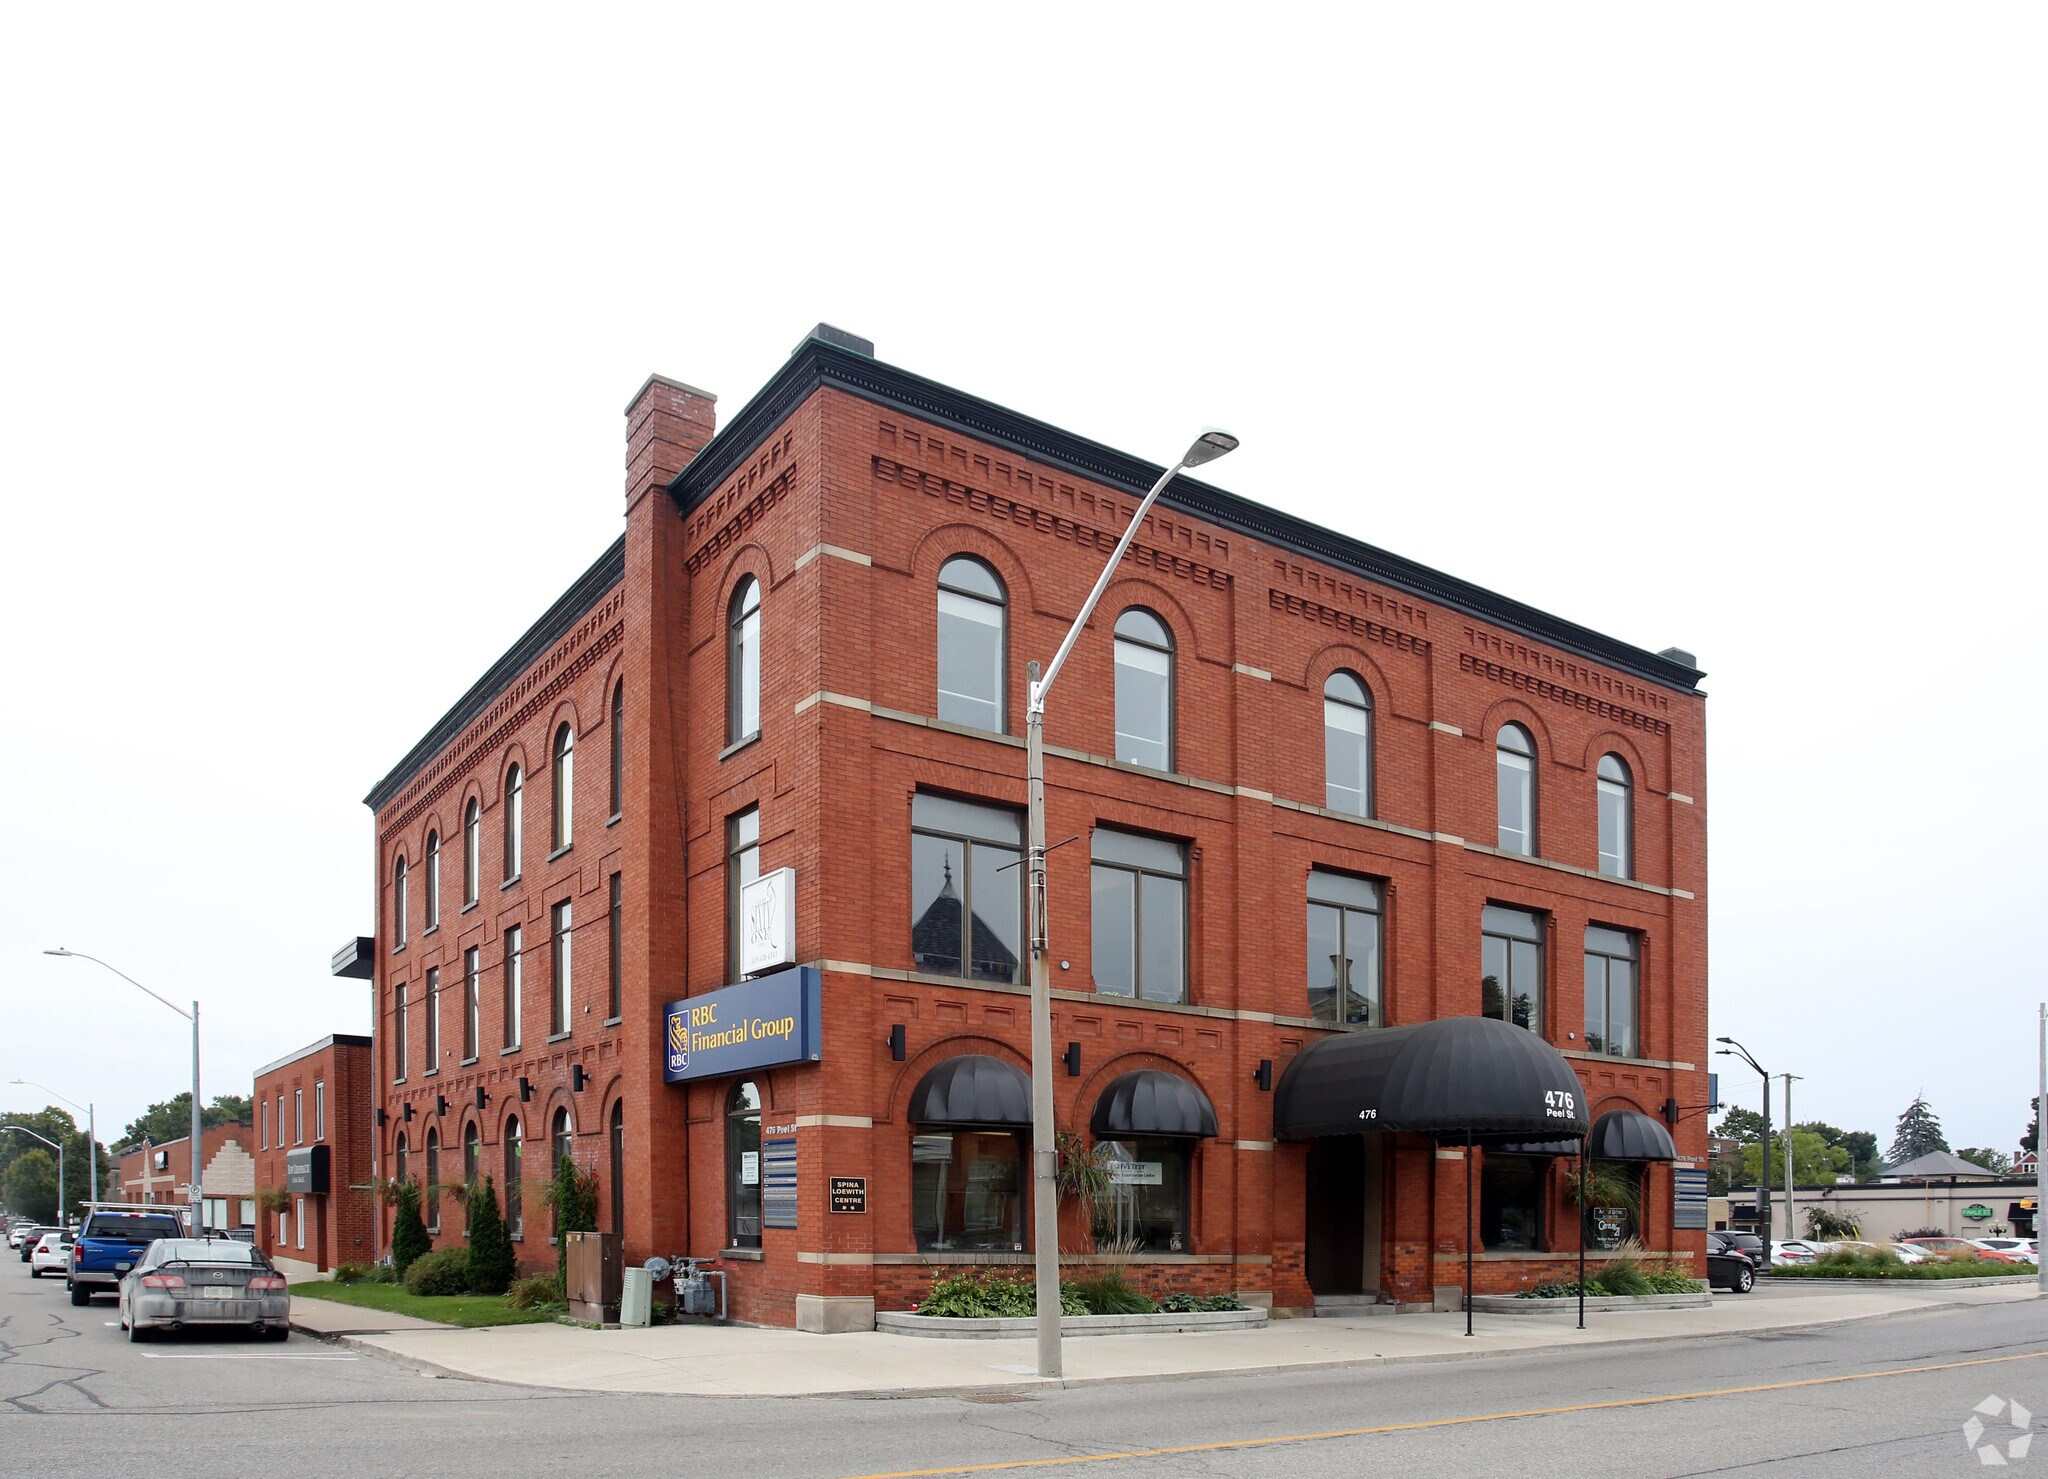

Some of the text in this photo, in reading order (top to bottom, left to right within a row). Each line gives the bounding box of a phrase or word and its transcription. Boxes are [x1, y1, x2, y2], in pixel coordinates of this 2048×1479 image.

[751, 930, 770, 944] ONE
[691, 1003, 718, 1028] RBC
[691, 1016, 794, 1052] Financial Group
[671, 1052, 688, 1068] RBC
[1544, 1090, 1575, 1110] 476
[1358, 1109, 1377, 1120] 476
[1546, 1108, 1576, 1120] Peel St.
[765, 1126, 776, 1135] 476
[777, 1124, 790, 1134] Peel
